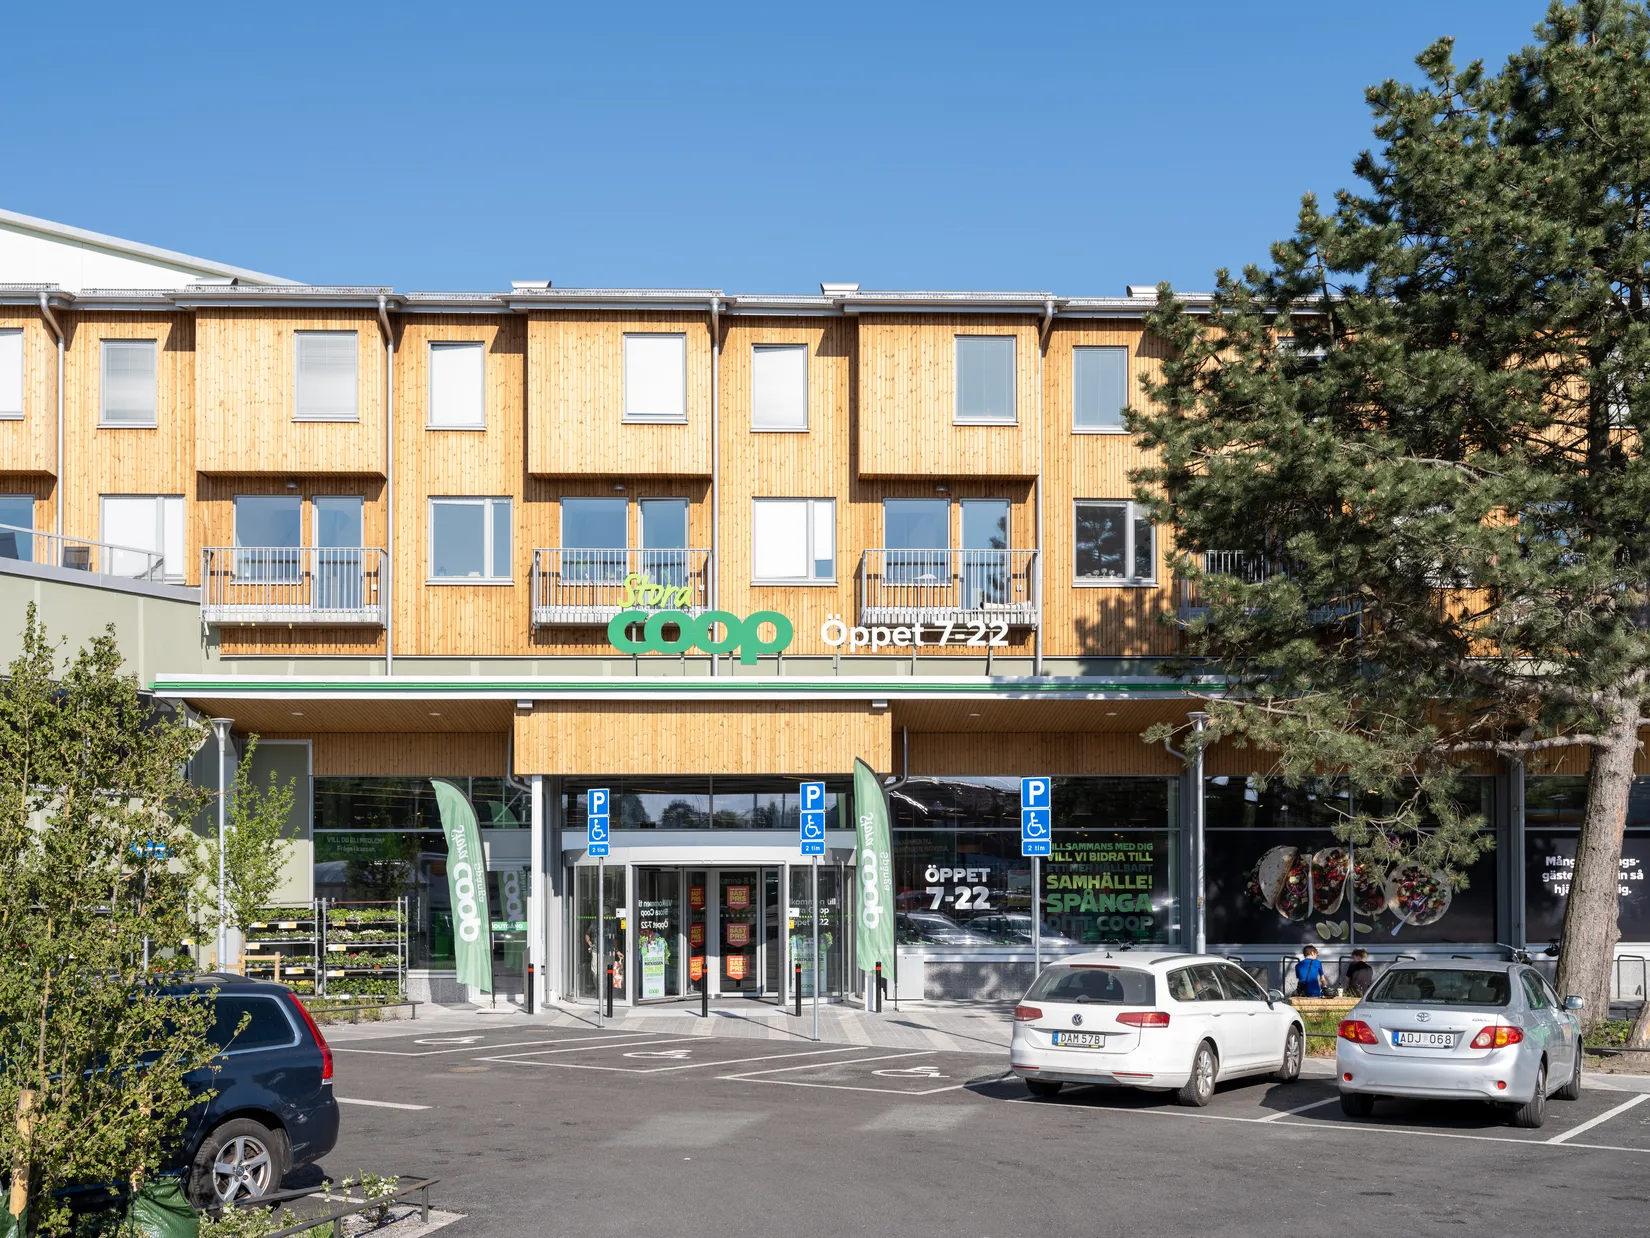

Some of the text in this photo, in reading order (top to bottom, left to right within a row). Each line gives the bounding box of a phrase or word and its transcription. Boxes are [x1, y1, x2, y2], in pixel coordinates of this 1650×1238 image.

[617, 573, 694, 608] Stora
[608, 610, 794, 665] coop
[820, 613, 1009, 652] Öppet 7-22
[806, 785, 820, 808] P
[1028, 780, 1045, 806] P
[593, 792, 606, 814] P
[1115, 842, 1136, 850] MED
[1137, 842, 1153, 850] DIG
[1046, 852, 1153, 861] VILL VI BIDRA TILL
[1546, 856, 1576, 868] Mång
[924, 864, 991, 883] ÖPPET
[1046, 864, 1068, 872] ETT
[1070, 864, 1092, 872] MER
[1542, 870, 1573, 882] gäste
[1630, 869, 1644, 880] så
[1046, 872, 1153, 889] SAMHÄLLE!
[926, 886, 991, 910] 7-22
[1618, 884, 1632, 896] ig.
[1046, 888, 1153, 912] SPÅNGA
[1046, 916, 1154, 931] DITT COOP
[1061, 1033, 1100, 1044] DAM 57B
[1400, 1034, 1452, 1044] ADJ 068
